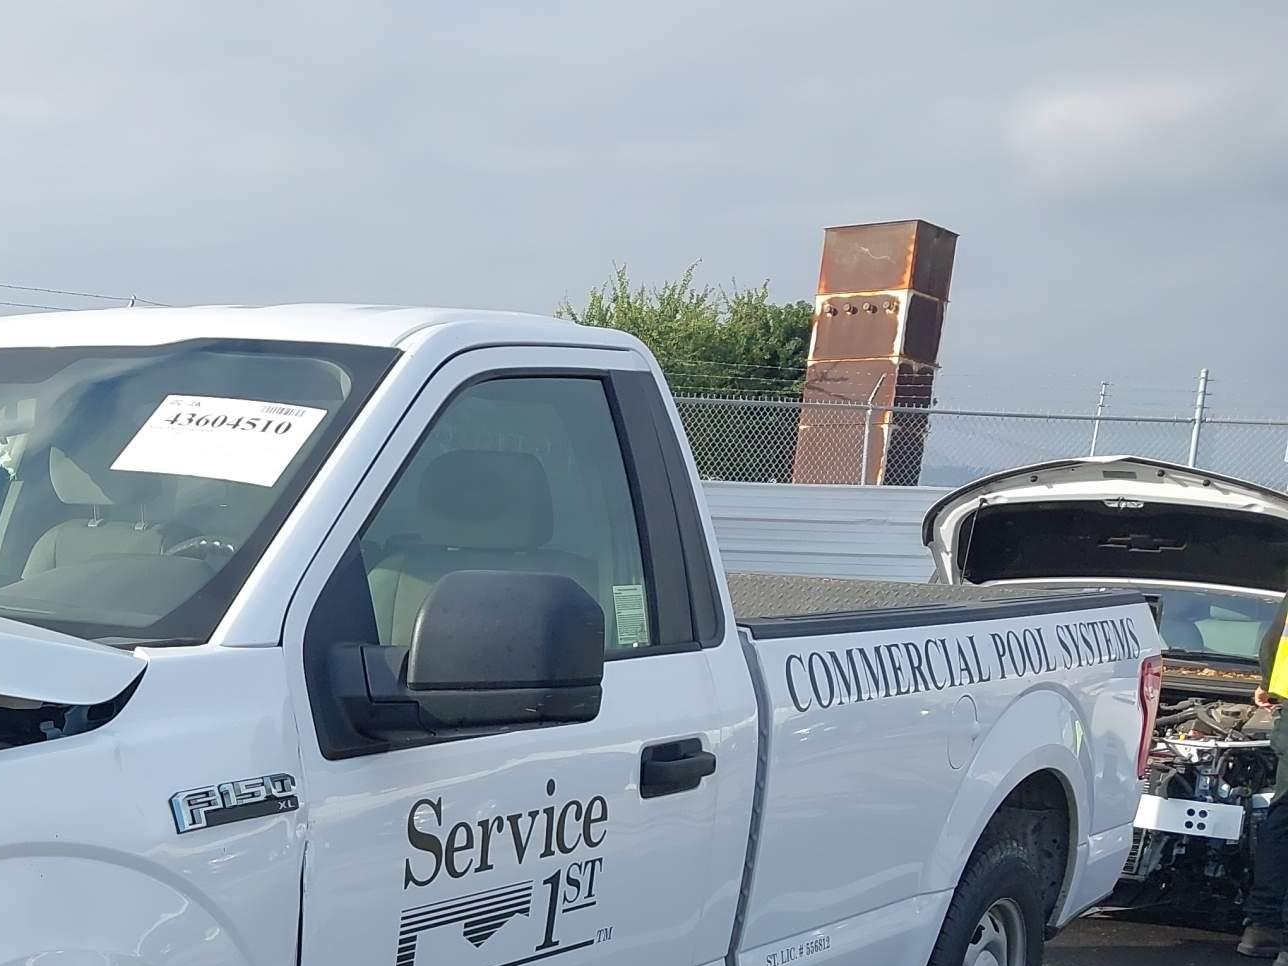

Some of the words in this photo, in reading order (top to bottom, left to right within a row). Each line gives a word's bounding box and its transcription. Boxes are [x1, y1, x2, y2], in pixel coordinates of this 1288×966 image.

[165, 412, 292, 435] 43604510
[785, 635, 991, 712] COMMERCIAL
[990, 627, 1057, 679] POOL
[1056, 617, 1141, 670] SYSTEMS
[169, 773, 296, 834] F150
[278, 800, 296, 810] XL
[404, 778, 609, 890] Service
[781, 947, 798, 964] LIC.
